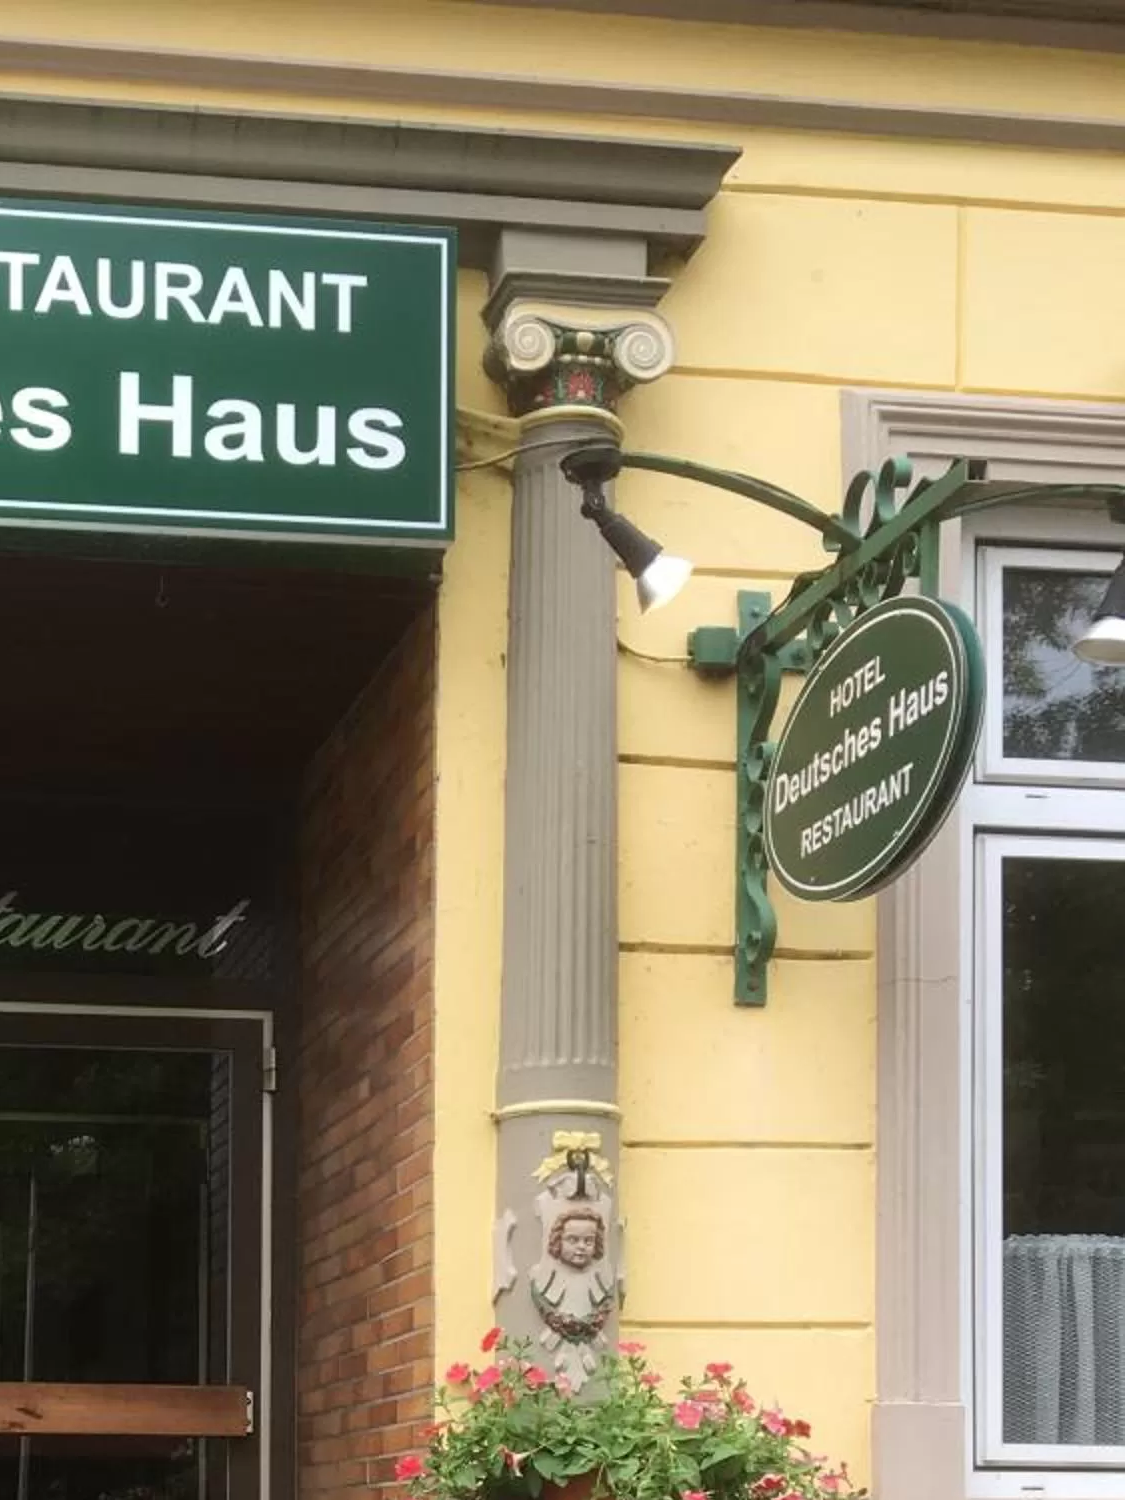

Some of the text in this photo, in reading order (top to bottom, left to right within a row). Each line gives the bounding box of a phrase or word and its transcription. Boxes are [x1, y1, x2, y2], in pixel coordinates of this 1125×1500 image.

[117, 370, 407, 471] Haus
[829, 655, 887, 719] HOTEL
[774, 670, 949, 815] Deutsches Haus
[800, 761, 914, 859] RESTAURANT
